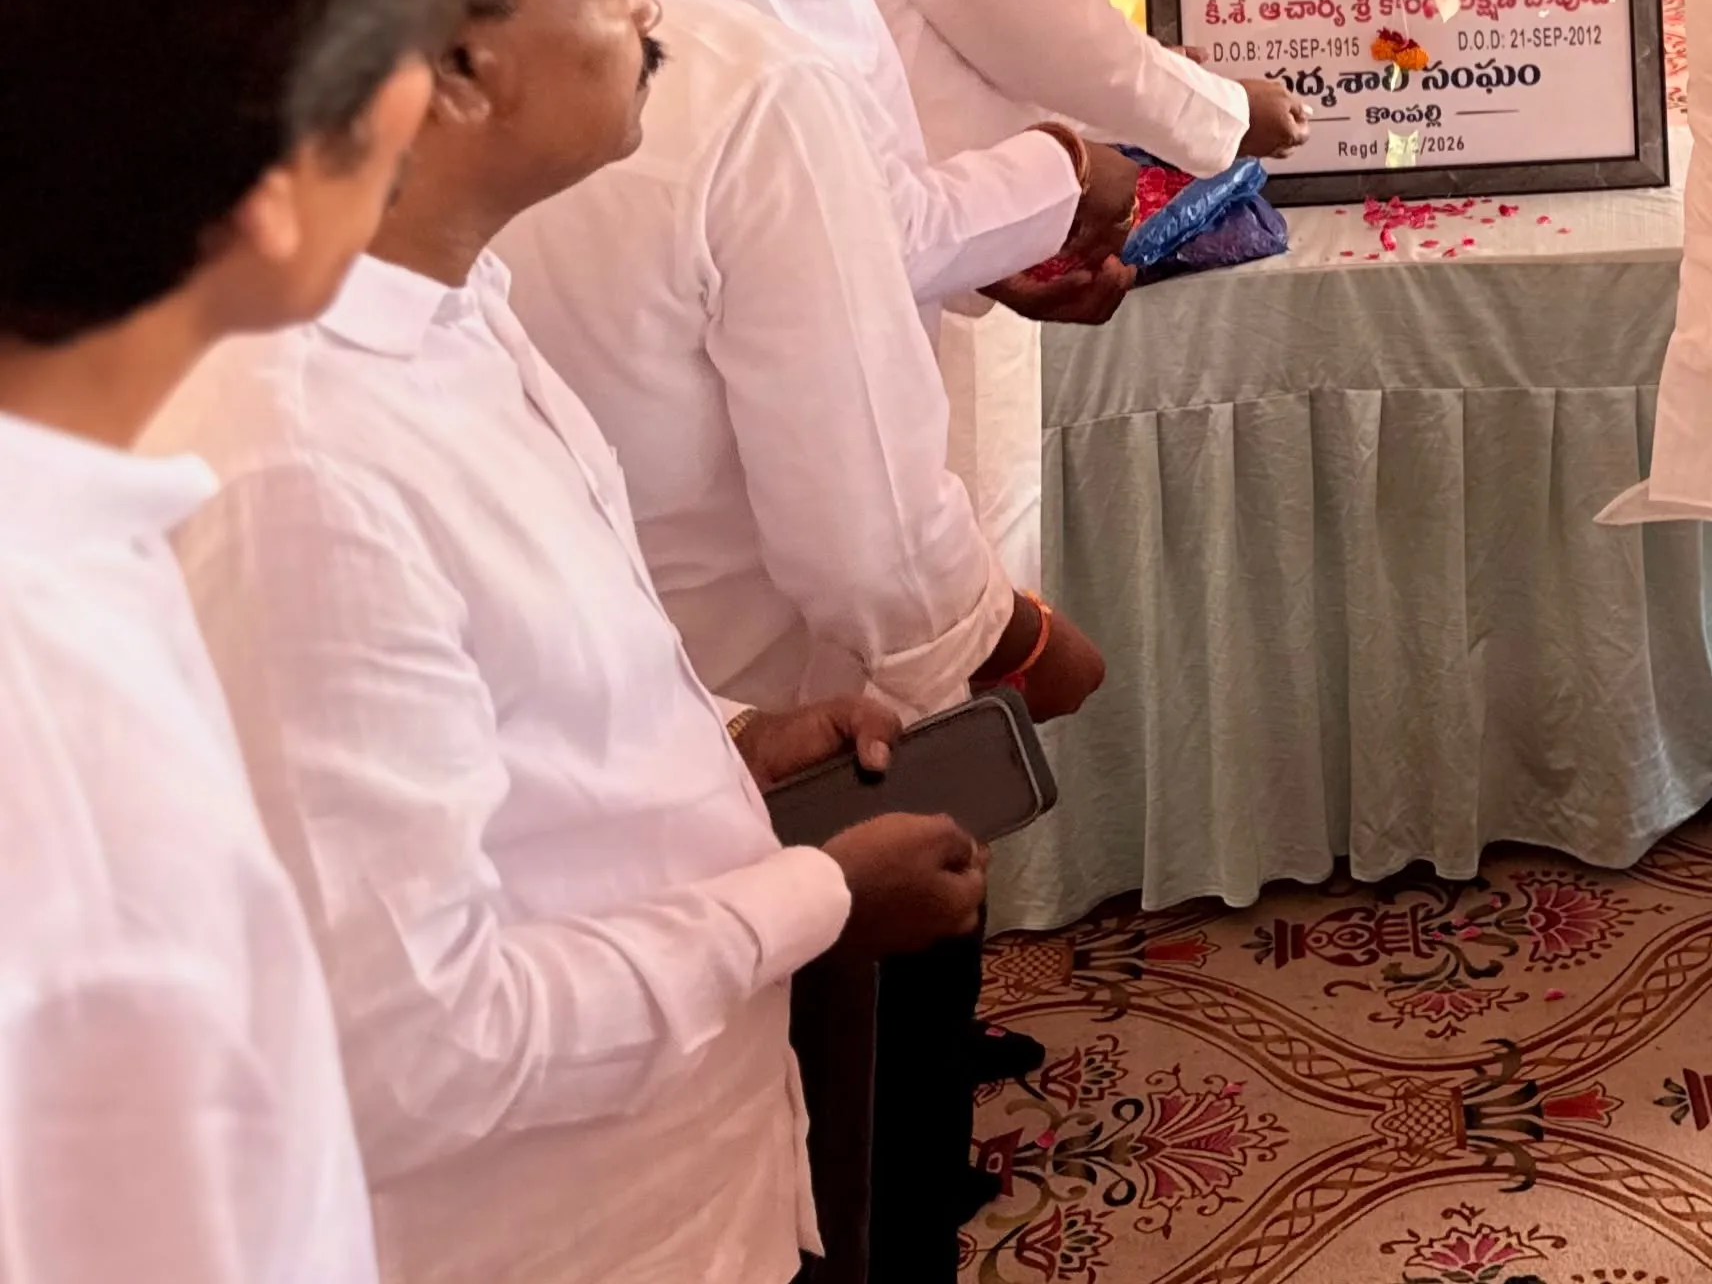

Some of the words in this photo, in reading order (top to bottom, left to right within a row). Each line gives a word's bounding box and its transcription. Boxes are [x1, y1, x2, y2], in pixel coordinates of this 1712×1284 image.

[1213, 41, 1261, 63] D.O.B:
[1266, 36, 1361, 61] 27-SEP-1915
[1457, 29, 1505, 51] D.O.D:
[1510, 24, 1602, 50] 21-SEP-2012
[1421, 57, 1542, 94] సంఘం
[1365, 103, 1443, 128] కొంపల్లి
[1338, 139, 1378, 160] Regd
